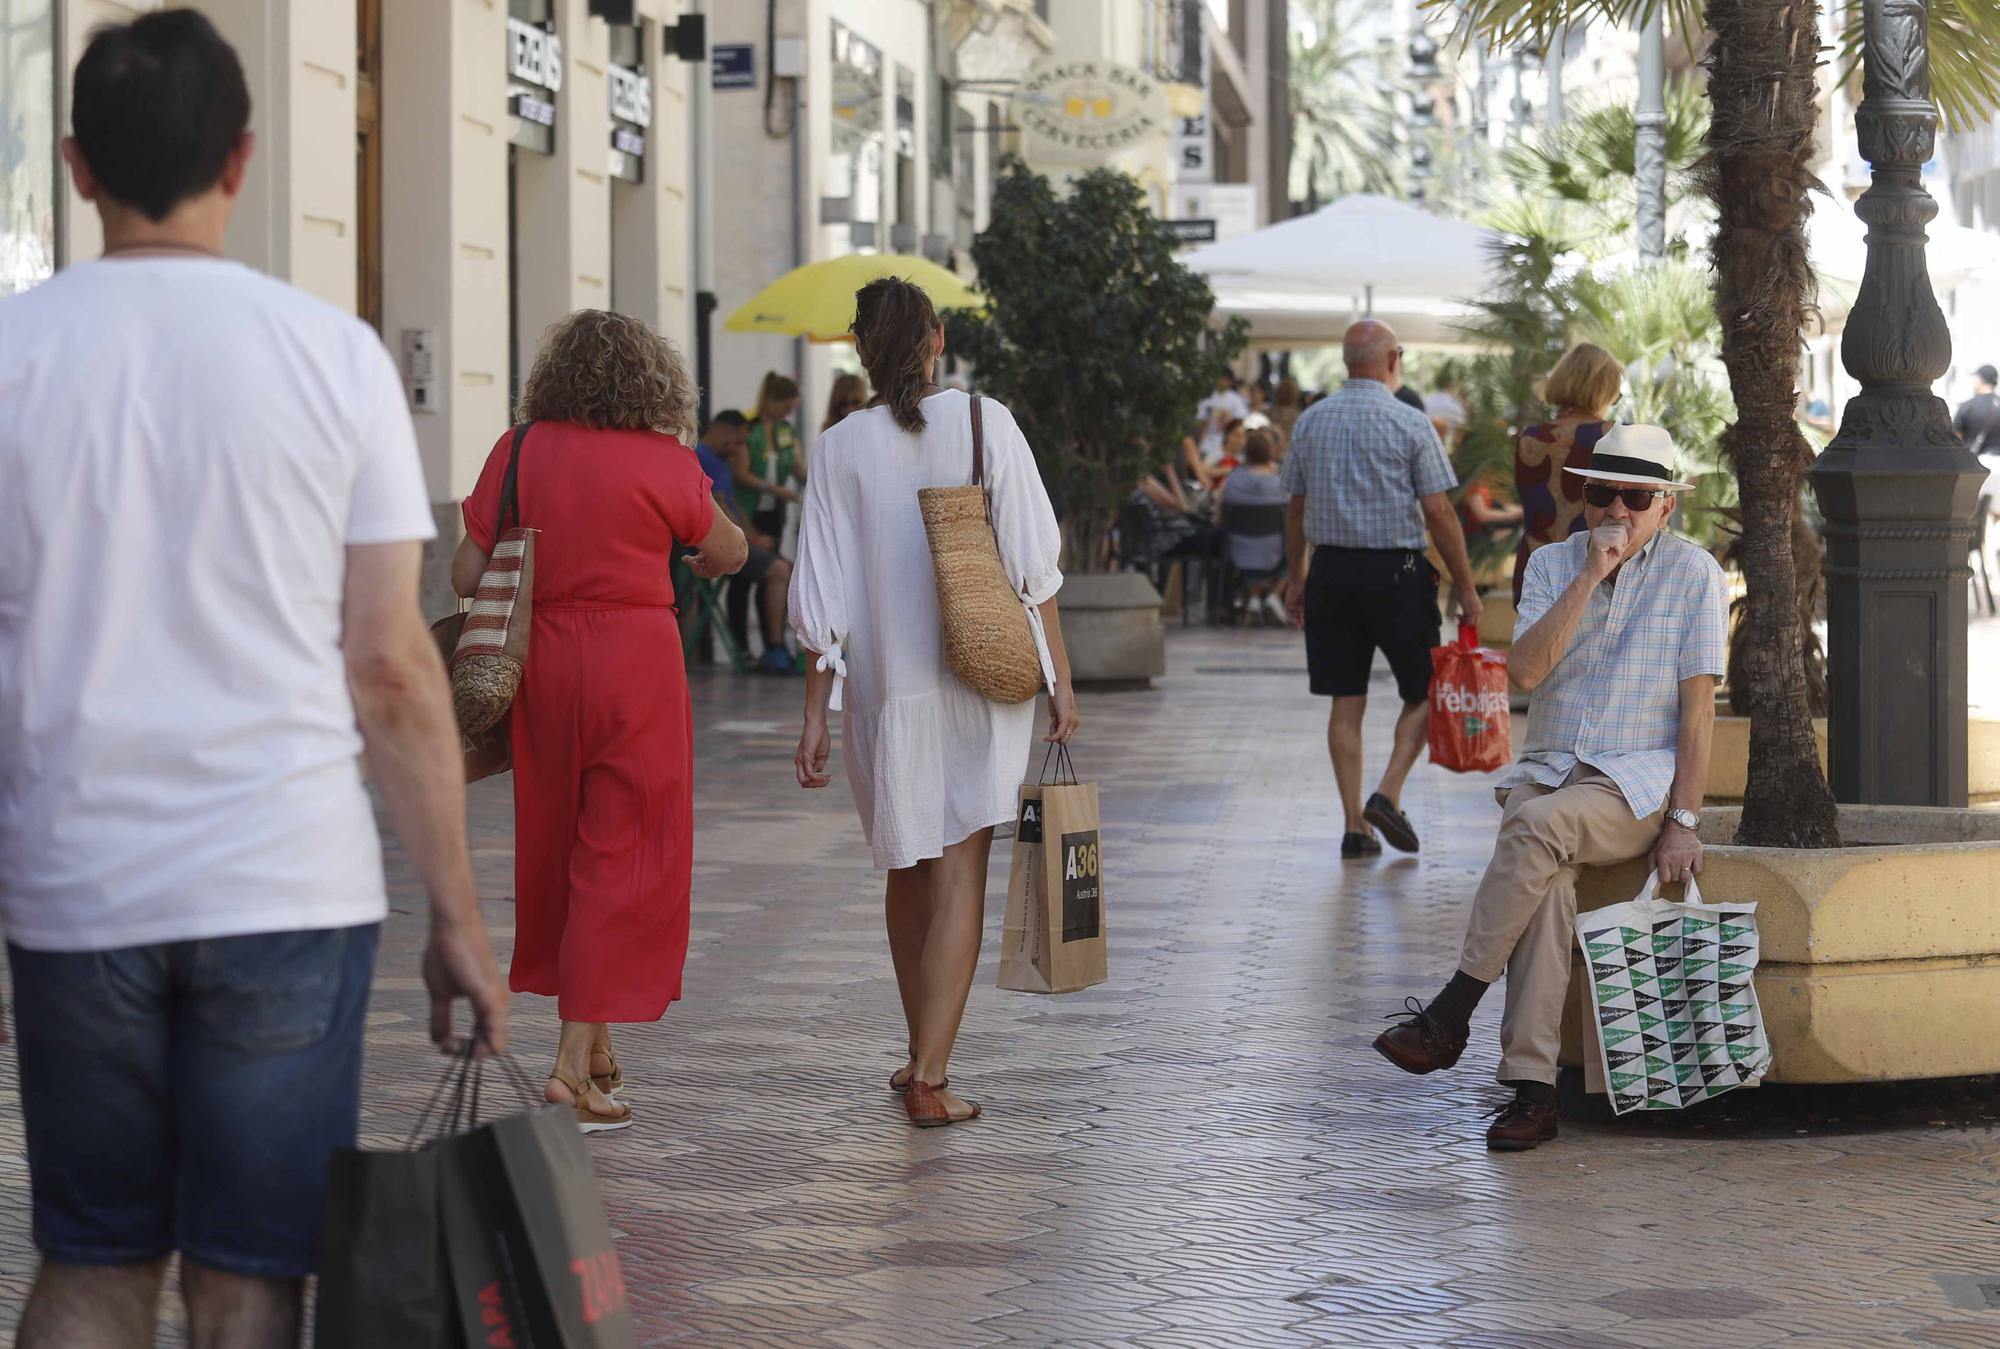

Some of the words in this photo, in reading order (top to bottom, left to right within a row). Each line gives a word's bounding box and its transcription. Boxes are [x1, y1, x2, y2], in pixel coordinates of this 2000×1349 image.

[1110, 67, 1152, 99] BAR
[1436, 684, 1510, 719] rebajas
[1066, 844, 1097, 880] A36
